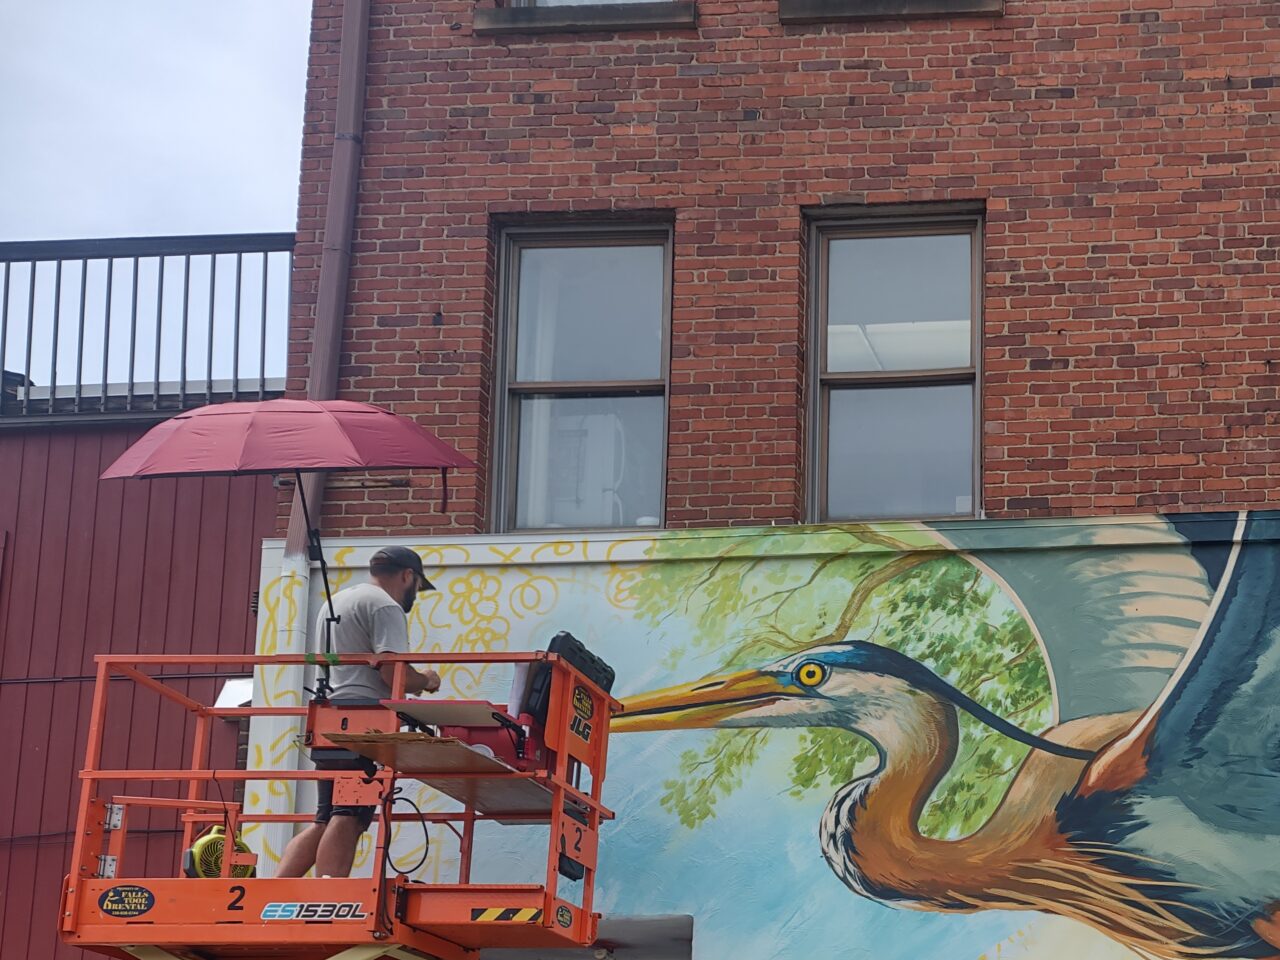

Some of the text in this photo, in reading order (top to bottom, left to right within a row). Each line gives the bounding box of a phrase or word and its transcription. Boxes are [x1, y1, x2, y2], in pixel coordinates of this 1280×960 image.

[570, 715, 592, 741] JLG
[574, 826, 583, 852] 2
[227, 885, 246, 911] 2
[261, 903, 368, 919] ES1530L
